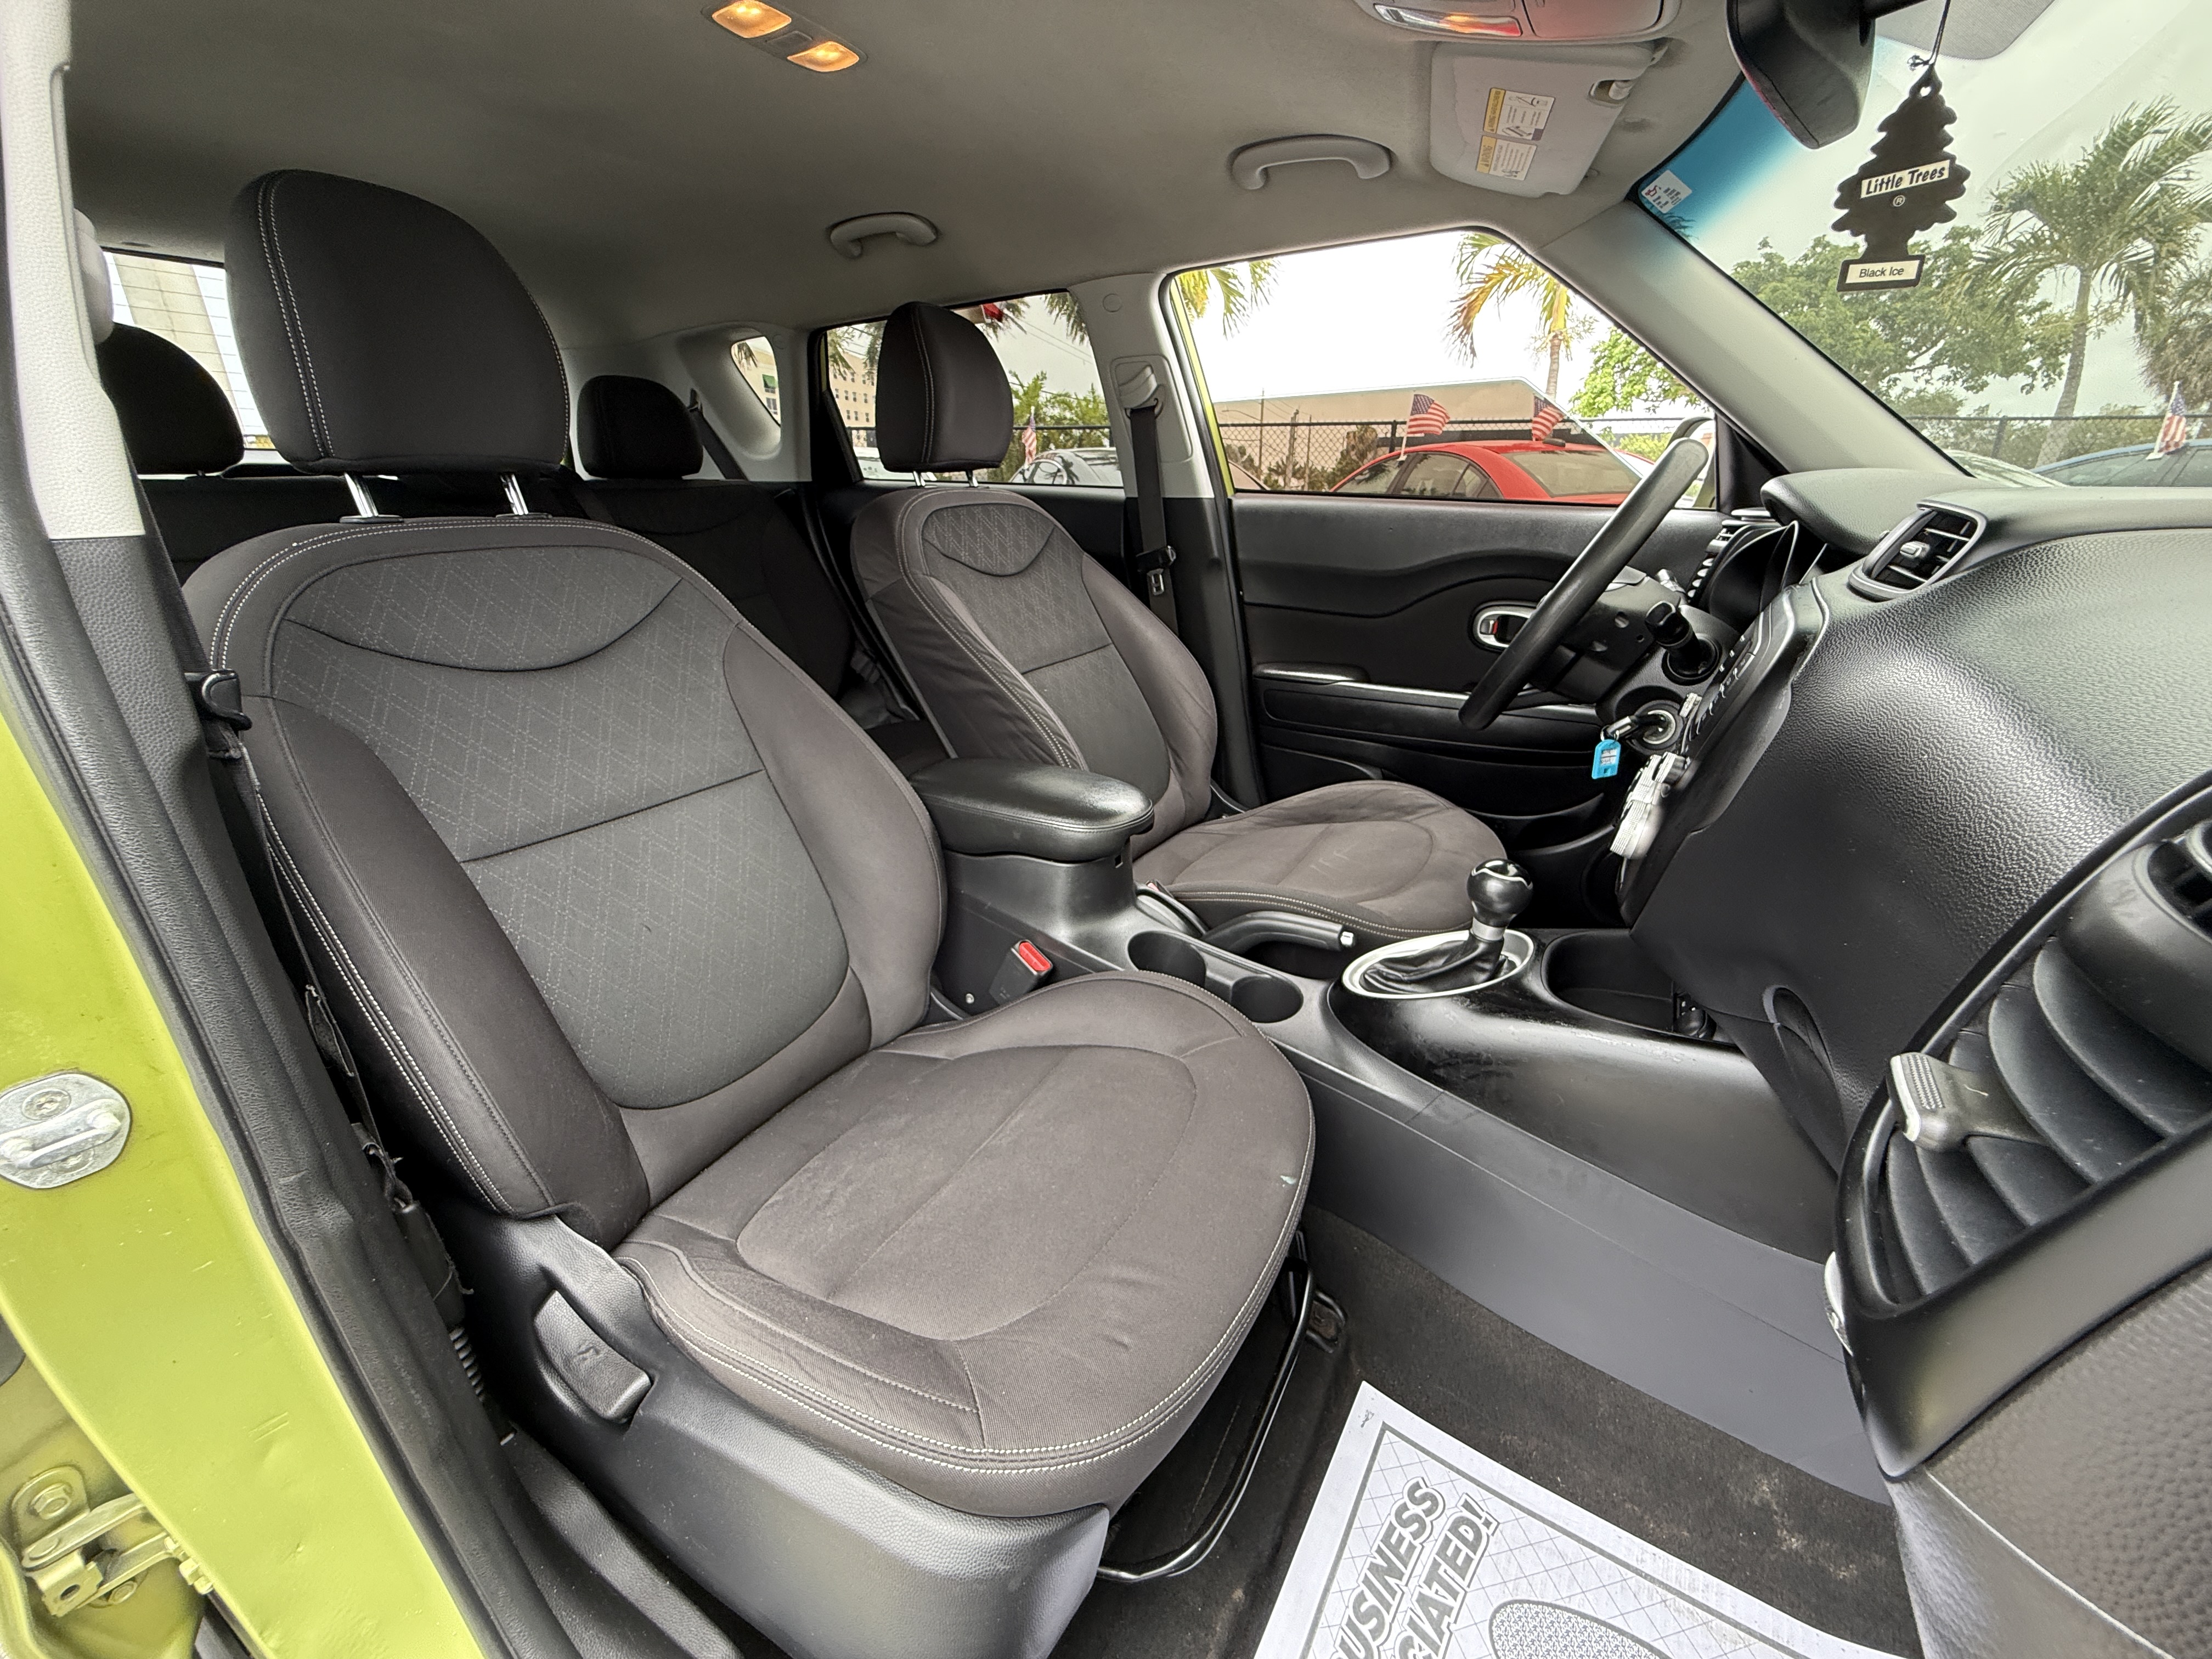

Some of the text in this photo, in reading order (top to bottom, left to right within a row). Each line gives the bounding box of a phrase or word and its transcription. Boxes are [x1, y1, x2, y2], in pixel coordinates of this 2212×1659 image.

[1865, 166, 1946, 195] Little Trees
[1859, 267, 1905, 278] Black Ice
[1332, 1478, 1444, 1659] USINESS
